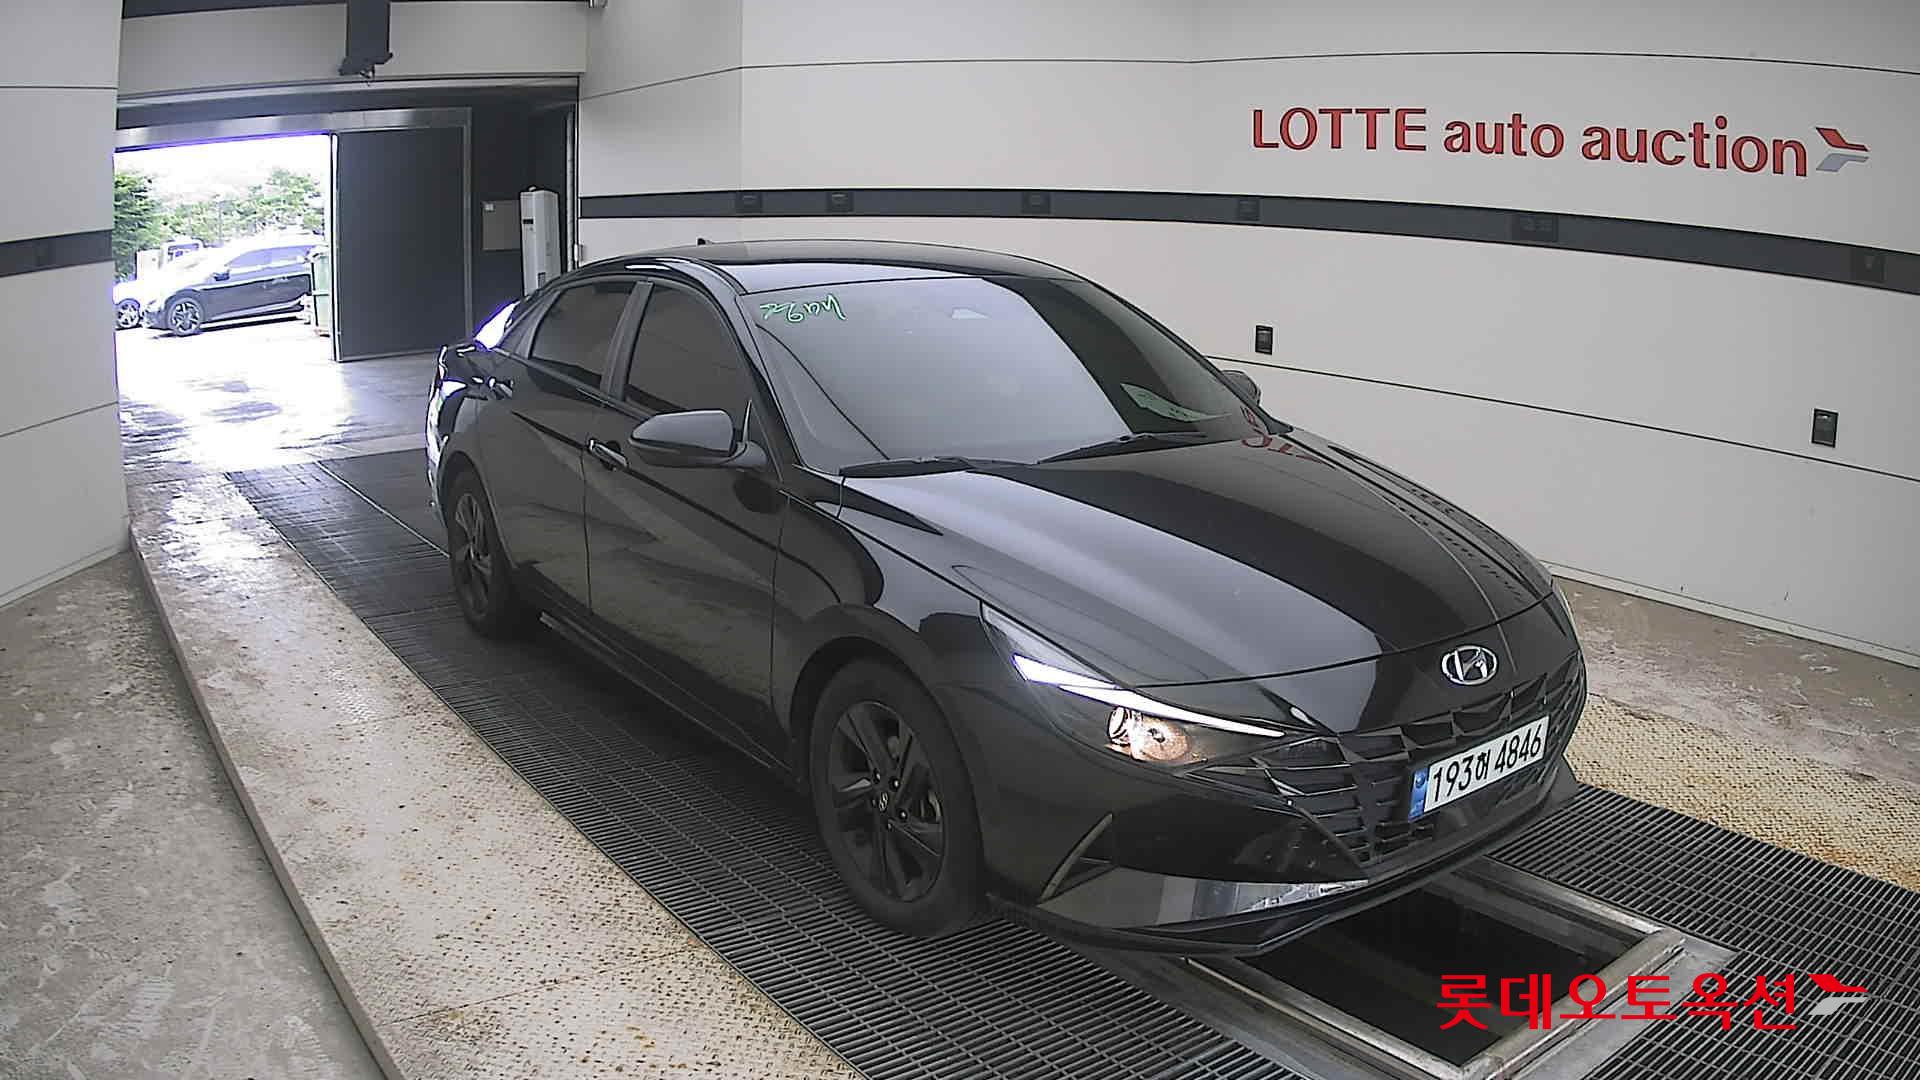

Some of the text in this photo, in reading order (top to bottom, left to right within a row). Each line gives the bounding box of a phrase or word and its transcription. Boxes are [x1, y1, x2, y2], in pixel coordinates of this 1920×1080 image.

[1252, 107, 1808, 177] LOTTE auto auction
[1494, 723, 1543, 773] 4846
